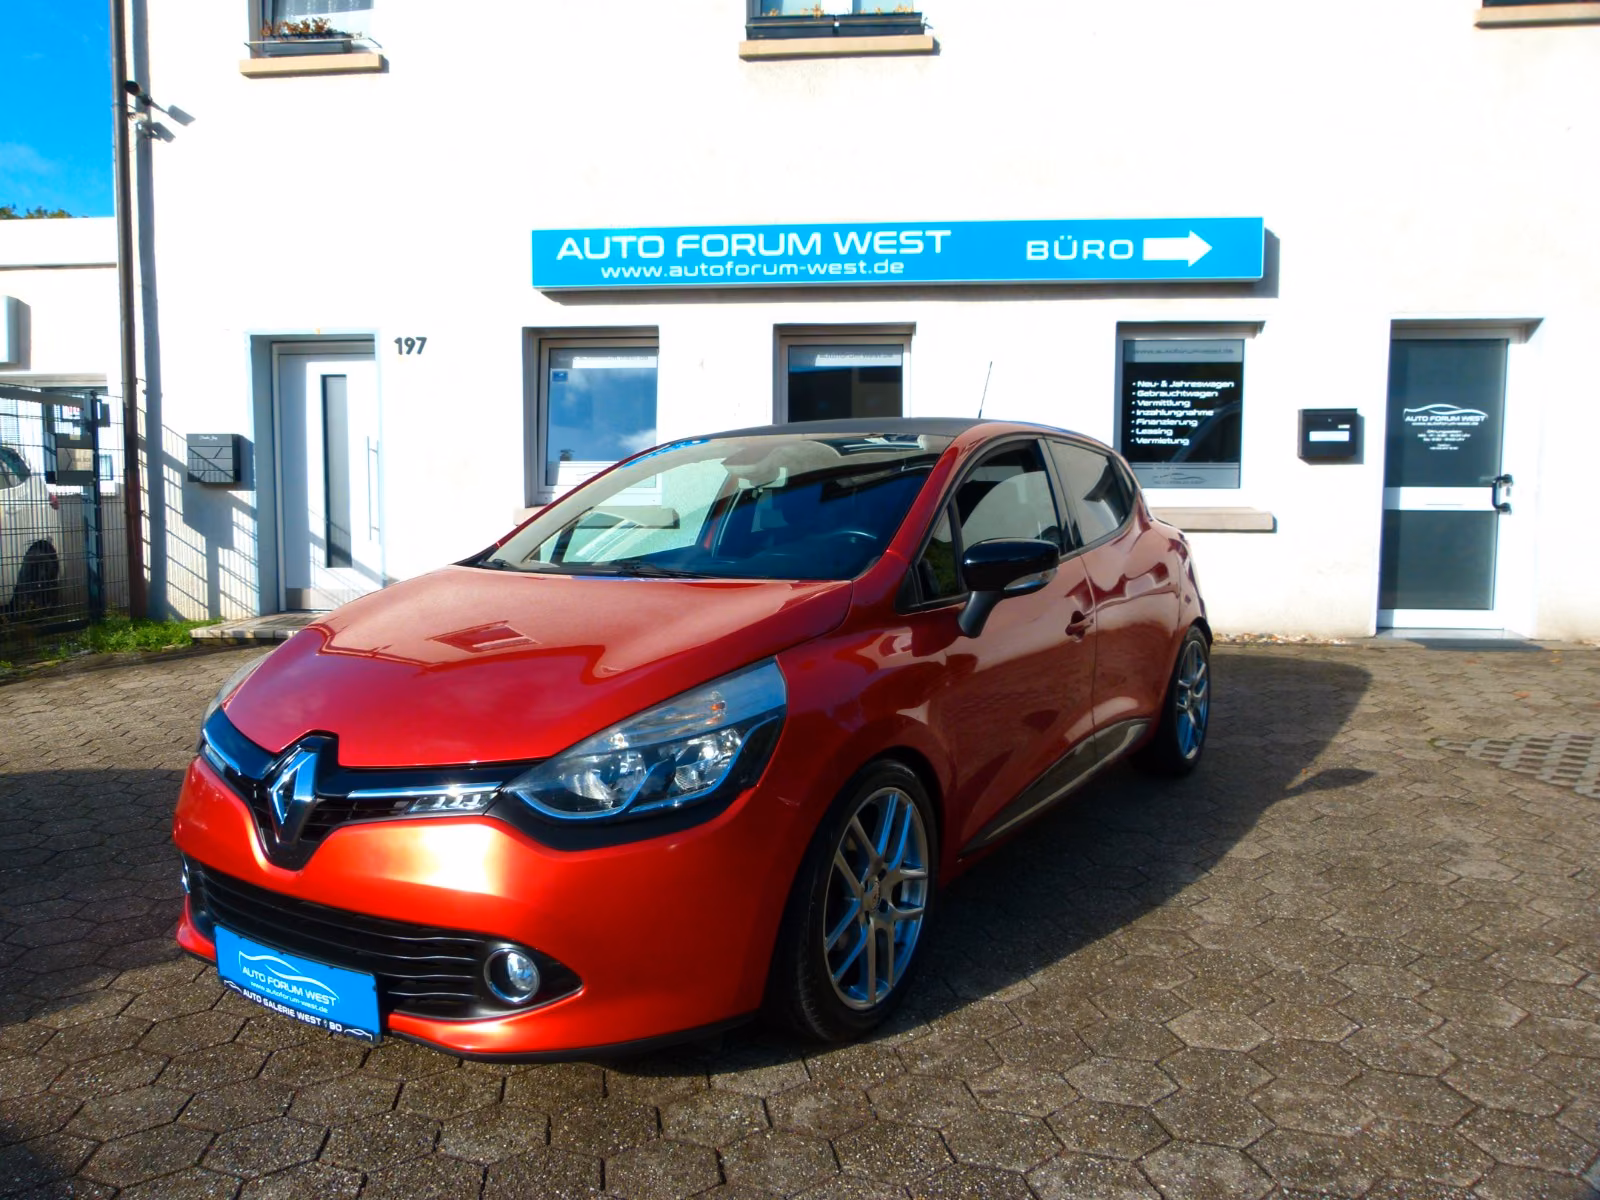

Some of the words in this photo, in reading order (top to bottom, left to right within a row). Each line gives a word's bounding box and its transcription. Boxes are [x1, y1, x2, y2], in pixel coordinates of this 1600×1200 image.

[556, 234, 664, 260] AUTO
[676, 232, 822, 258] FORUM
[833, 230, 952, 255] WEST
[1026, 235, 1134, 260] BÜRO
[601, 259, 905, 279] www.autoforum-west.de
[393, 336, 428, 356] 197
[1169, 381, 1235, 390] Jahreswagen
[1136, 390, 1219, 399] Gebrauchtwagen
[1136, 399, 1191, 408] Vermittlung
[1136, 409, 1214, 417] Inzahlungnahme
[1135, 418, 1199, 427] Finanzierung
[1135, 427, 1174, 436] Leasing
[1135, 437, 1190, 446] Vermietung
[242, 966, 266, 982] AUTO
[267, 976, 304, 996] FORUM
[304, 989, 336, 1006] WEST
[250, 981, 329, 1014] www.autoforum-west.de
[243, 988, 262, 1003] AUTO
[262, 998, 296, 1018] GALERIE
[296, 1011, 322, 1026] WEST
